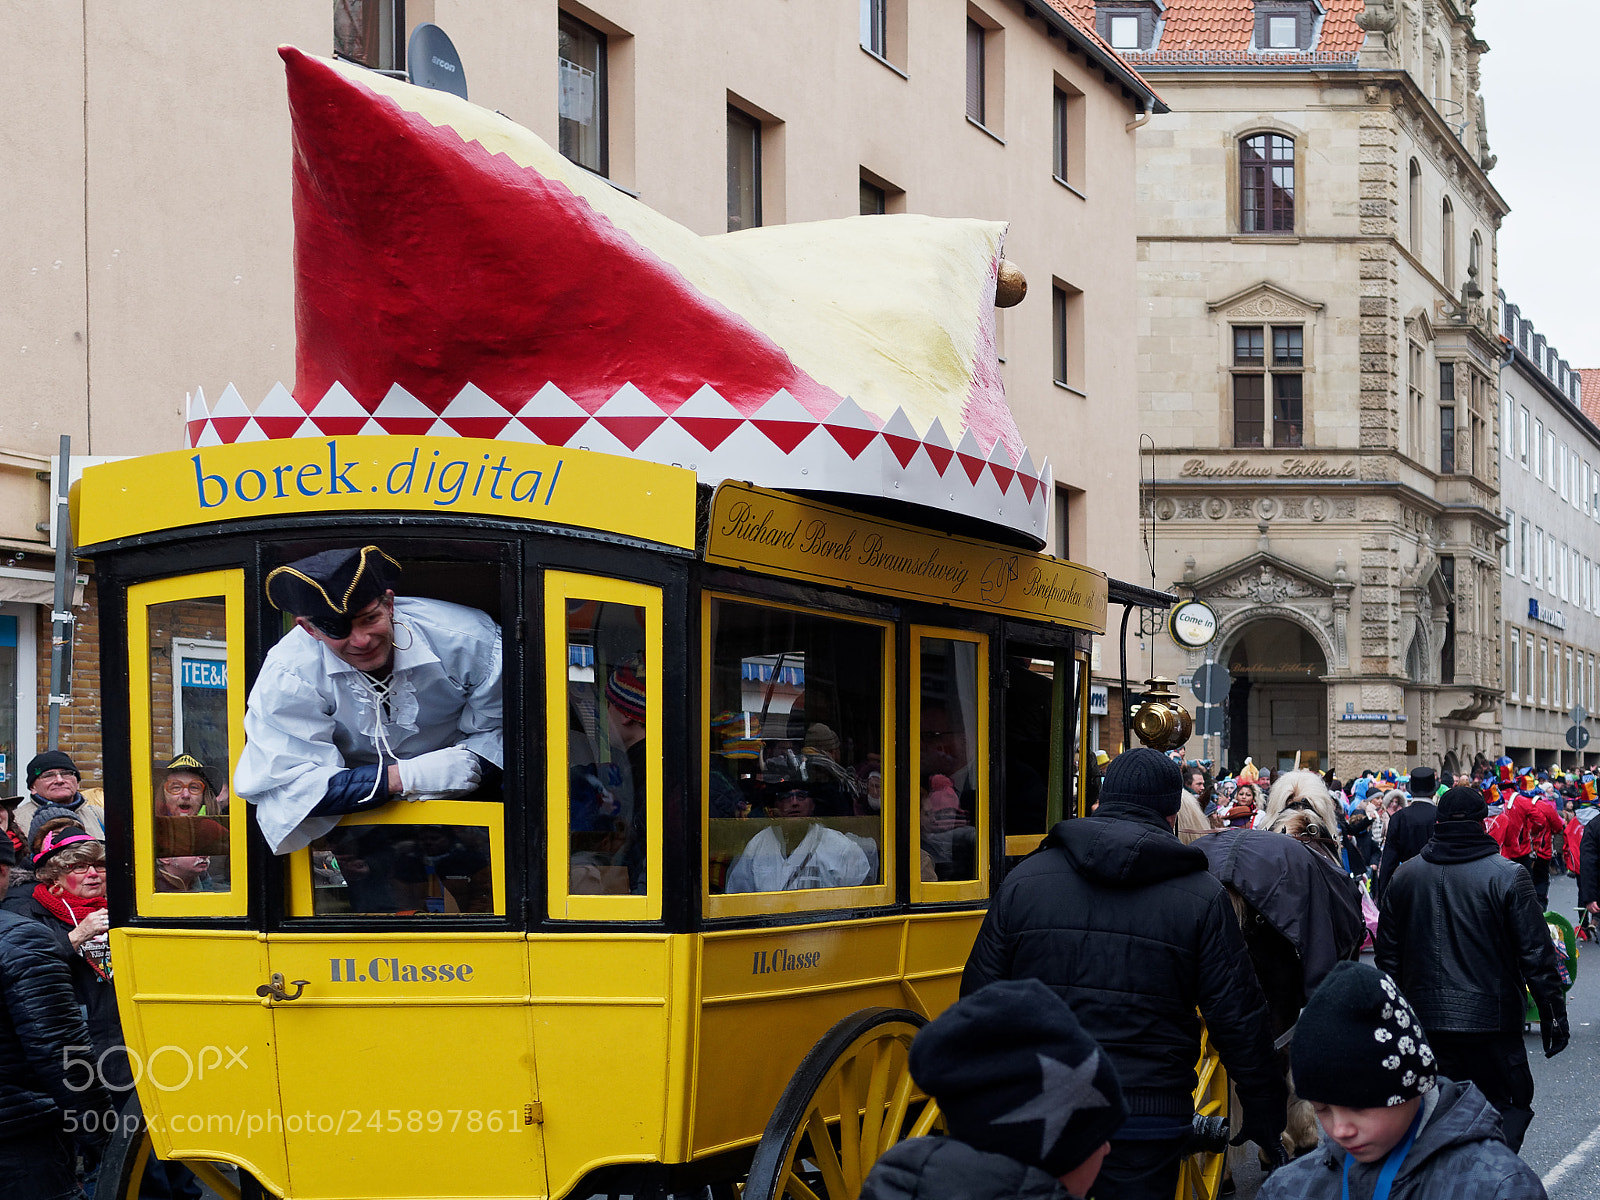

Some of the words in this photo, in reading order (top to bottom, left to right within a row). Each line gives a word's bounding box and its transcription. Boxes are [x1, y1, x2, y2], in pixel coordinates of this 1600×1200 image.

[431, 55, 456, 73] arcon
[190, 439, 563, 508] borek.digital
[1179, 457, 1273, 478] Bankhaus
[1275, 457, 1357, 478] Löbbecke
[721, 500, 802, 550] Richard
[799, 519, 857, 562] Borek
[857, 532, 969, 594] Braunschweig
[1022, 566, 1082, 610] Briefmarken
[1179, 612, 1203, 626] Come
